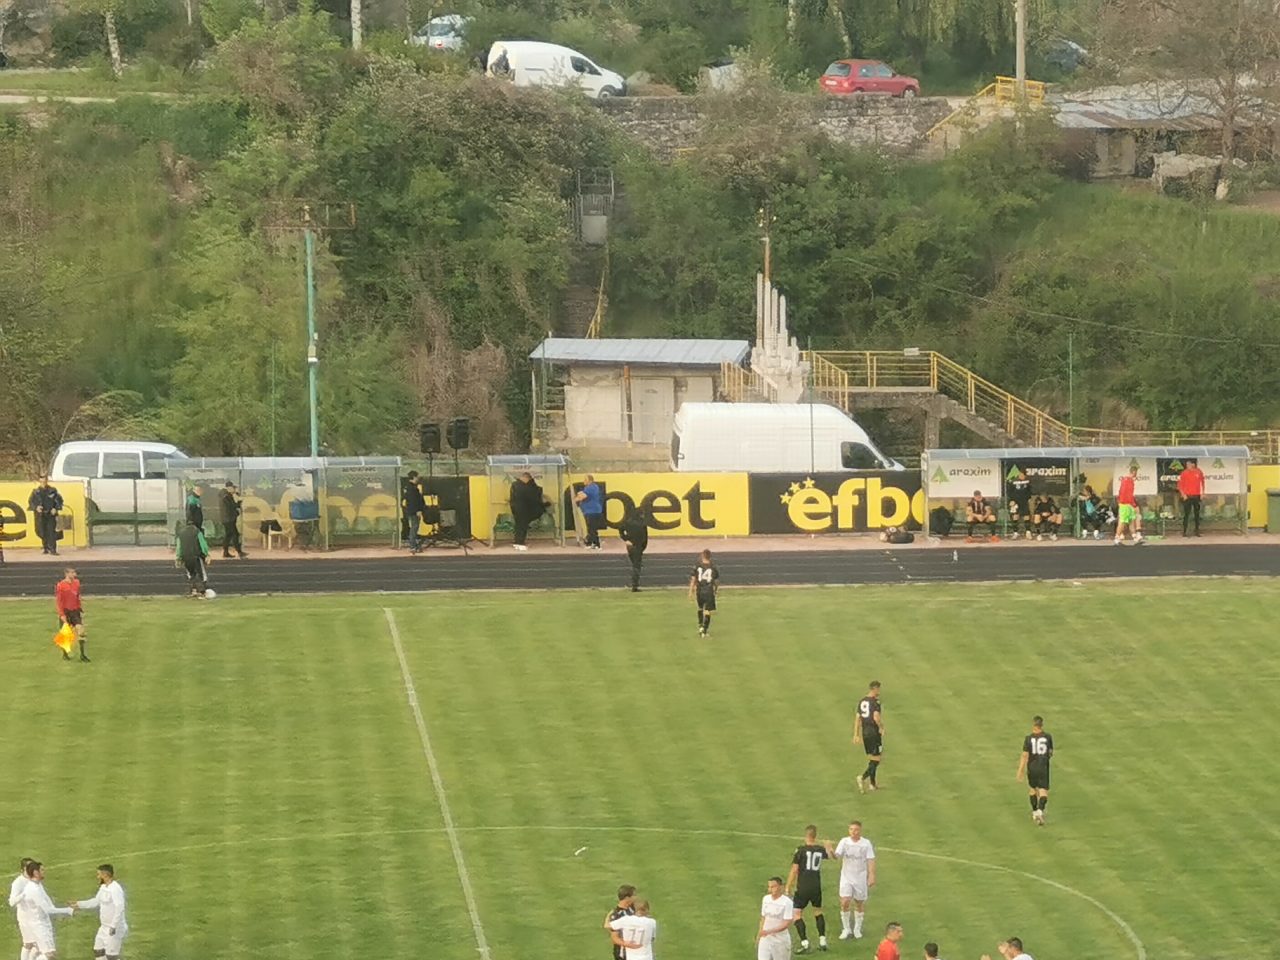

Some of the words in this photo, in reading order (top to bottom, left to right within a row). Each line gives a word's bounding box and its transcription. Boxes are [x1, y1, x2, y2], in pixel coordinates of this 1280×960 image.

[949, 466, 991, 477] araxim
[787, 477, 926, 531] efb
[697, 566, 713, 583] 14
[860, 700, 870, 718] 9
[1030, 736, 1048, 755] 16
[806, 850, 822, 871] 10
